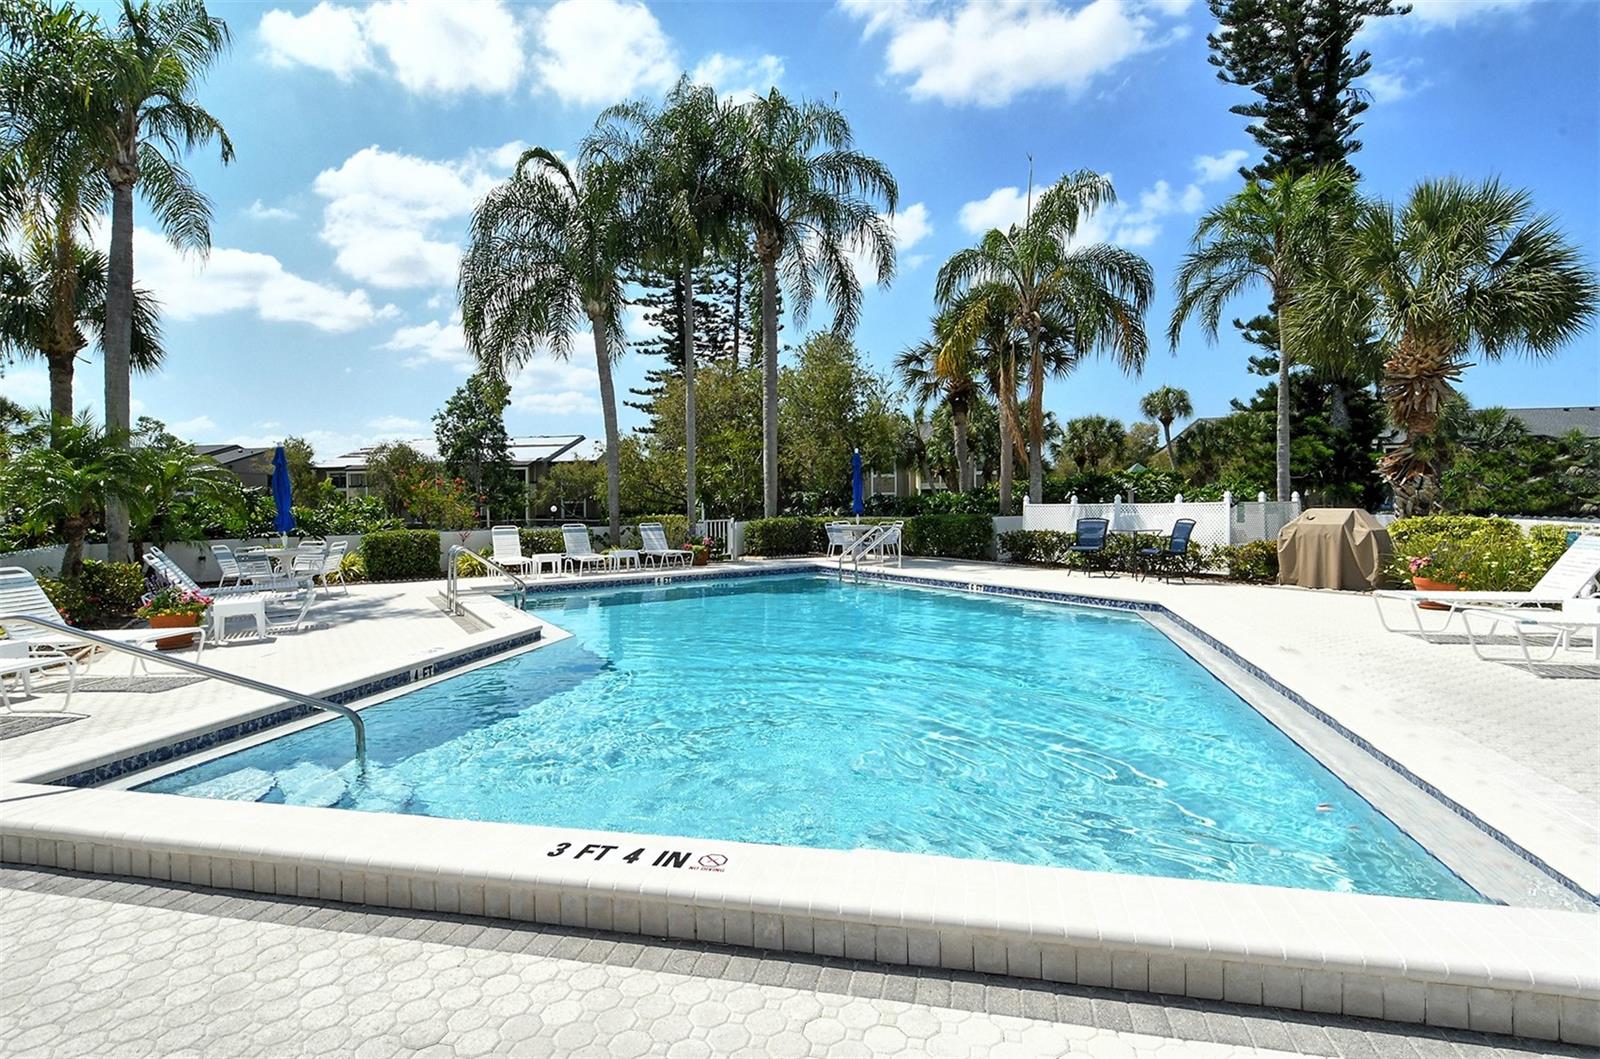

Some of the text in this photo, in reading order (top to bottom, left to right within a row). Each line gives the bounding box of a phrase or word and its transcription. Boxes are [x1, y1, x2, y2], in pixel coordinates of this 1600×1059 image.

[423, 665, 433, 678] FT
[547, 842, 692, 868] 3 FT 4 IN
